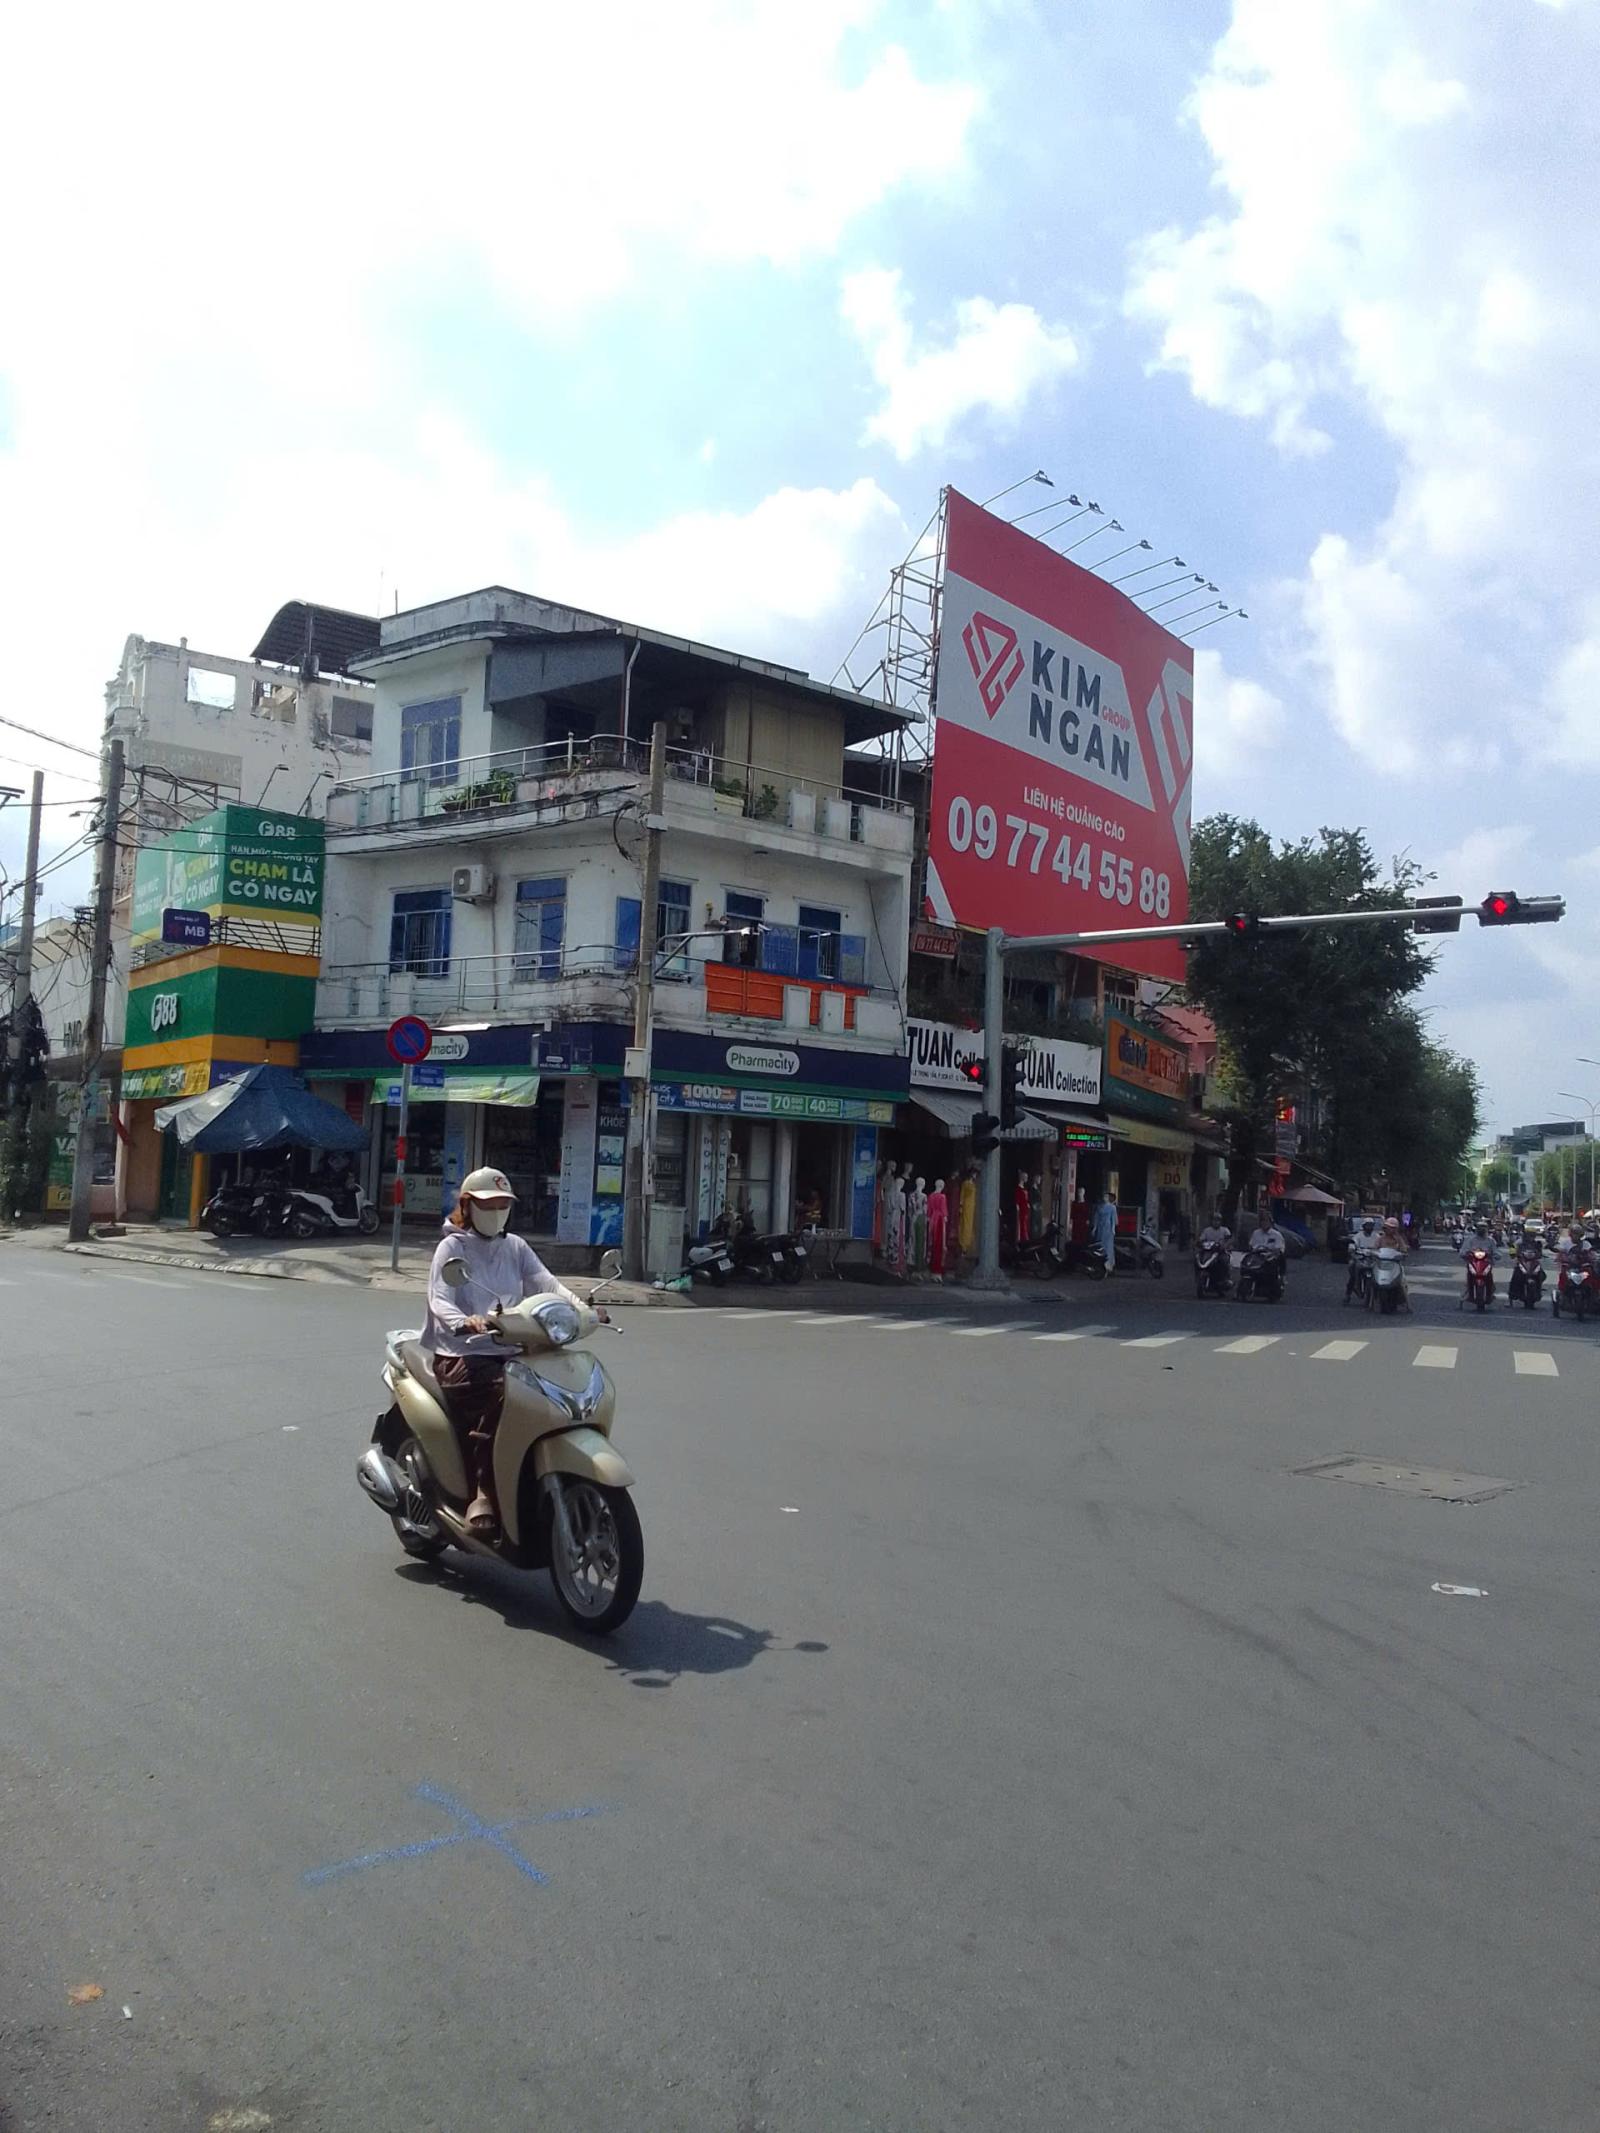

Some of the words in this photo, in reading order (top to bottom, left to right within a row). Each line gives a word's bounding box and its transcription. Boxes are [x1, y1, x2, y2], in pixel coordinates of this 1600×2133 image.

[1031, 640, 1101, 717] KIM
[1102, 705, 1131, 730] GROUP
[1029, 692, 1130, 782] NGAN
[1024, 787, 1049, 811] LIÊN
[1049, 796, 1065, 821] HỆ
[1066, 805, 1103, 831] QUẢNG
[1104, 820, 1126, 842] CÁO
[948, 796, 998, 860] 09
[1006, 814, 1049, 874] 77
[1052, 834, 1092, 891] 44
[1099, 850, 1134, 906] 55
[1139, 866, 1170, 919] 88
[230, 858, 288, 882] CHẠM
[292, 864, 315, 884] LÀ
[228, 878, 259, 898] CÓ
[264, 884, 317, 905] NGAY
[185, 926, 206, 937] MB
[430, 1039, 465, 1056] macity
[907, 1026, 954, 1069] TUAN
[731, 1052, 795, 1073] Pharmacity
[1056, 1070, 1098, 1095] Collection
[774, 1096, 791, 1109] 70
[809, 1099, 826, 1112] 40
